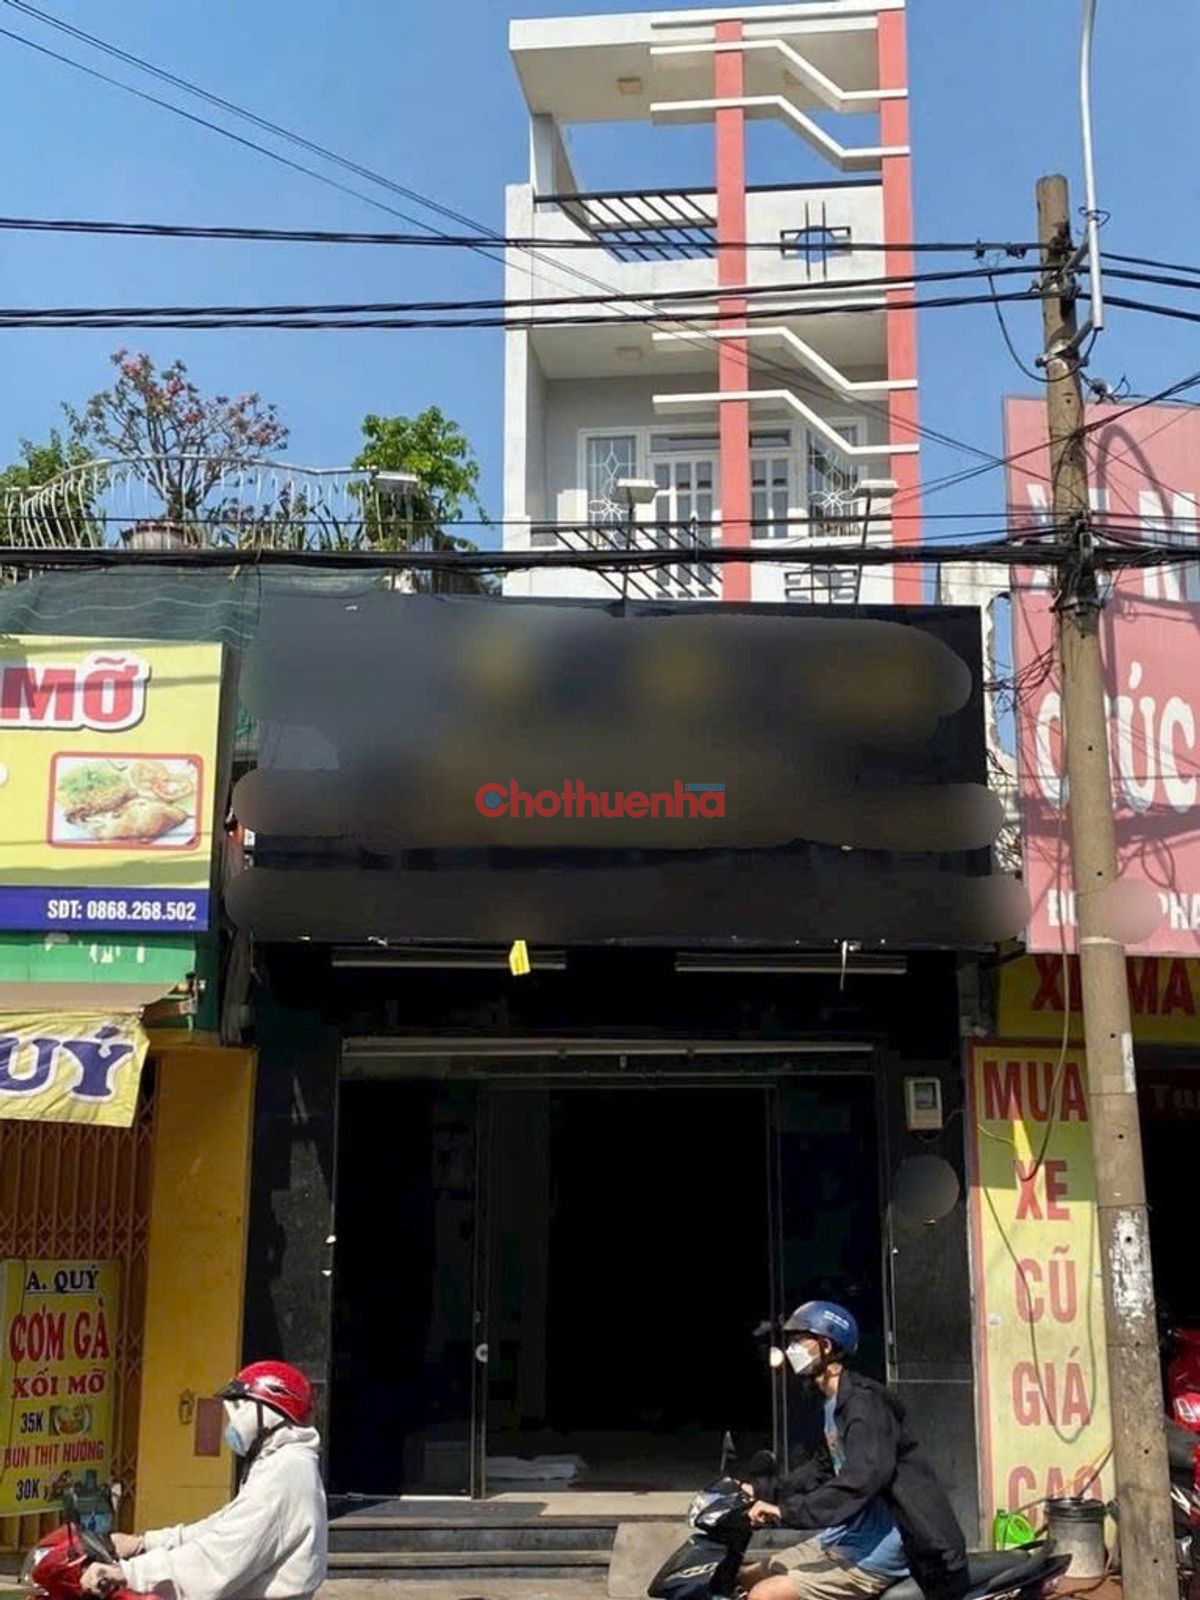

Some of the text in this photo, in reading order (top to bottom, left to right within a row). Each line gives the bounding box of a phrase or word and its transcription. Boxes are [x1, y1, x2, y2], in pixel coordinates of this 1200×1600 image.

[0, 657, 139, 723] MỠ
[87, 901, 197, 921] 0868.268.502
[982, 1061, 1089, 1122] MUA
[1013, 1160, 1071, 1221] XE
[26, 1265, 99, 1294] A. QUÝ
[1015, 1246, 1078, 1324] CŨ
[9, 1298, 110, 1363] CƠM GÀ
[1011, 1347, 1092, 1427] GIÁ
[20, 1412, 44, 1433] 35K
[16, 1477, 40, 1501] 30K
